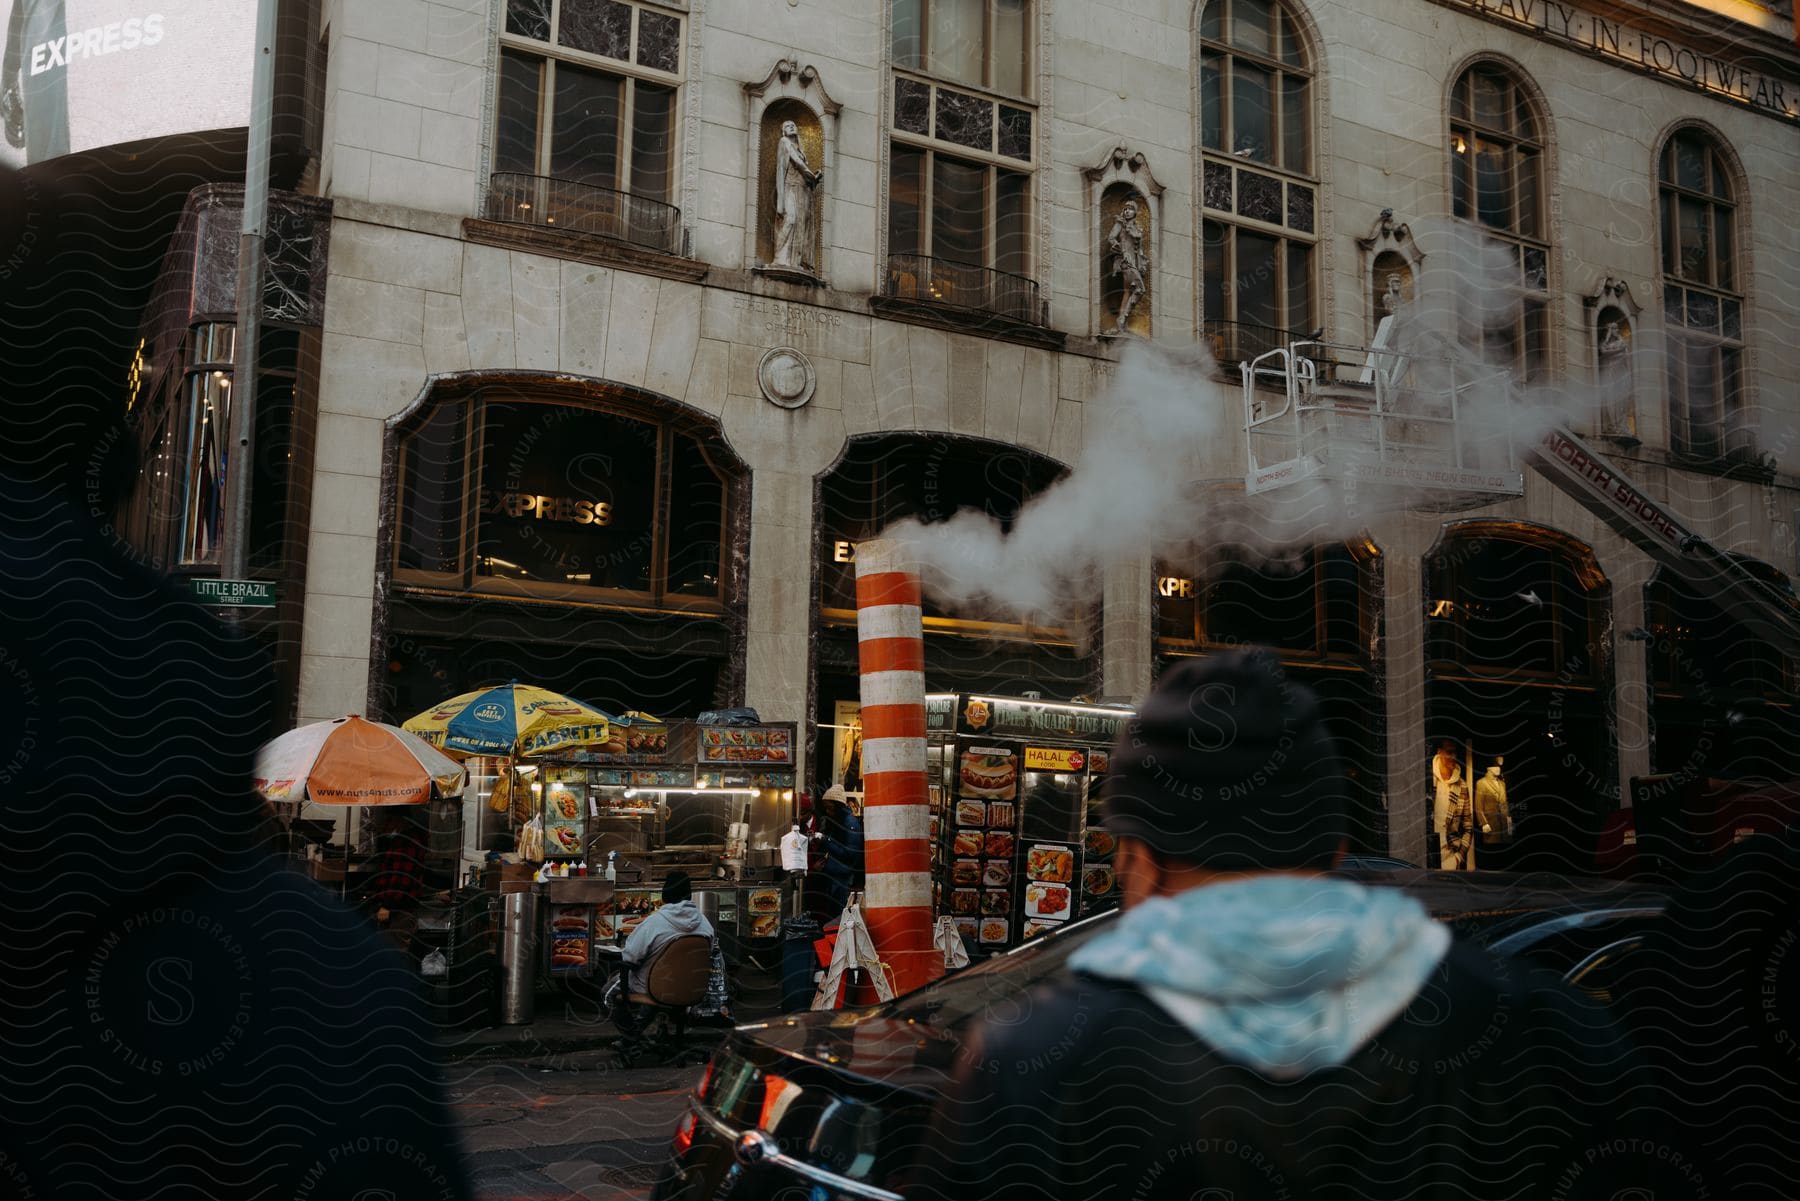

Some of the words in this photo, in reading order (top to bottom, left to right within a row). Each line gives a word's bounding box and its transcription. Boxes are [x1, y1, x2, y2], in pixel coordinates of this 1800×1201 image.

[31, 14, 164, 77] EXPRESS
[1592, 16, 1620, 55] IN
[1640, 33, 1792, 112] FOOTWEAR
[1426, 471, 1457, 483] NEON
[1460, 474, 1485, 485] SIGN
[1544, 431, 1611, 490] NORTH
[1614, 484, 1677, 542] SHORE
[196, 582, 229, 596] LITTLE
[232, 583, 269, 597] BRAZIL
[220, 595, 244, 604] STREET
[1030, 709, 1073, 730] SQUARE
[1075, 715, 1099, 733] FINE
[1101, 717, 1127, 735] FOO
[522, 723, 605, 752] SABRETT
[1028, 751, 1064, 762] HALAL
[316, 786, 422, 798] www.nuts4nuts.com
